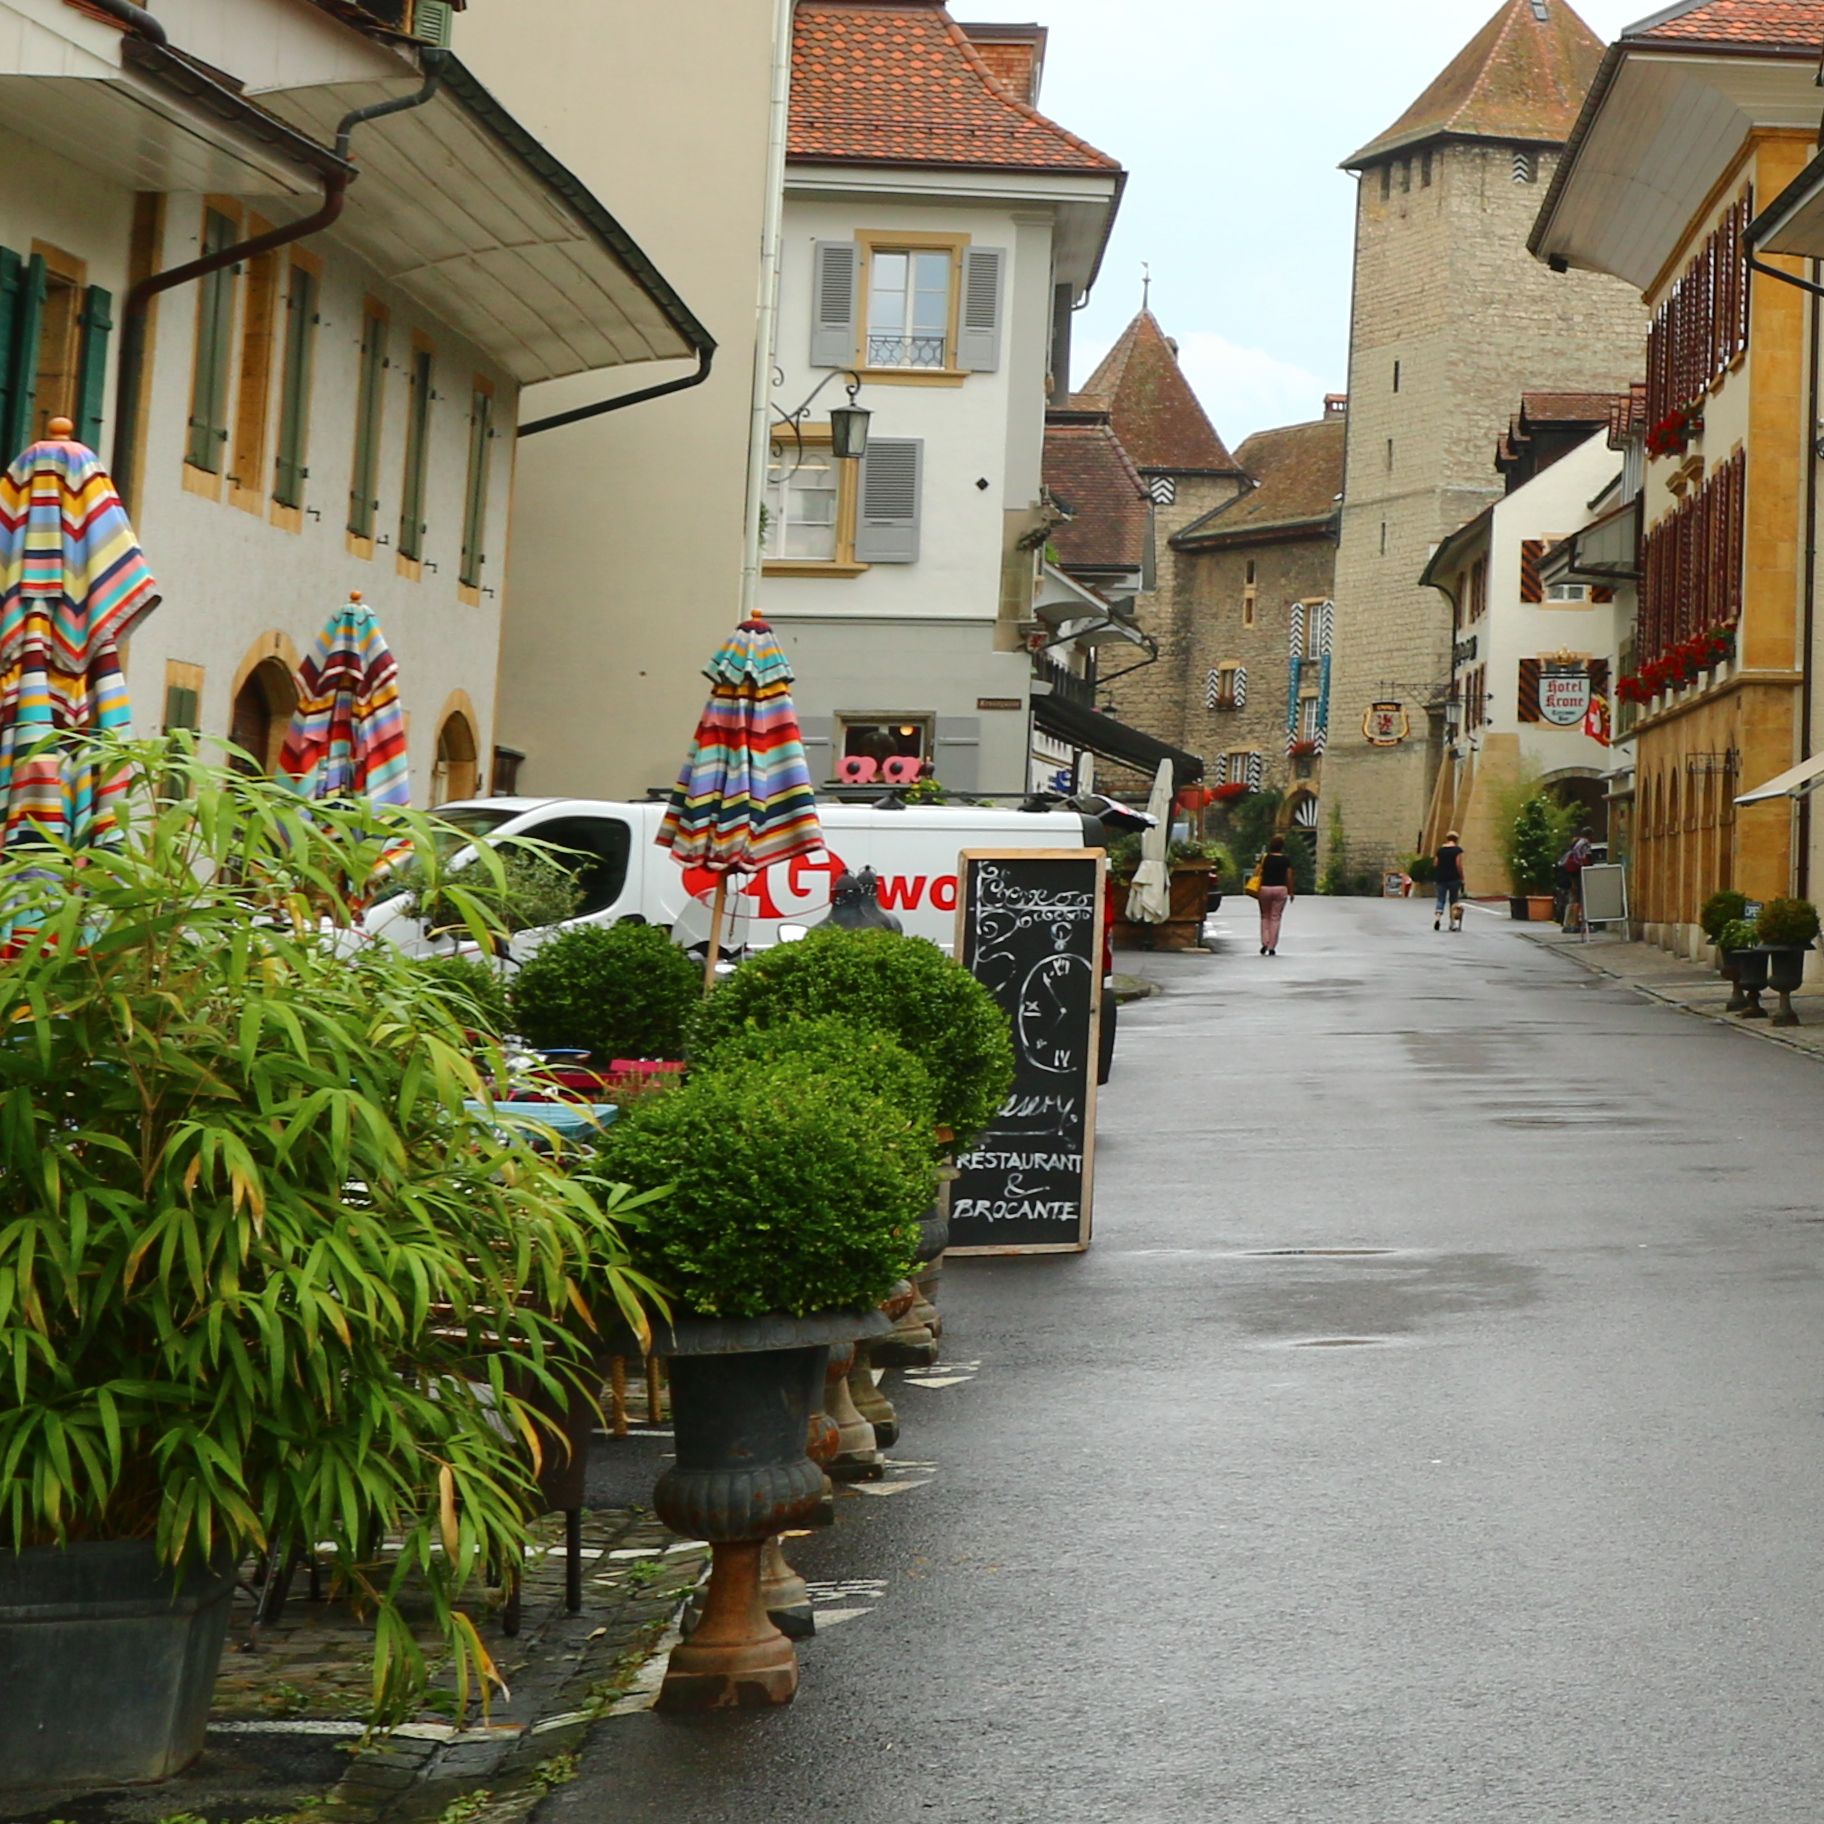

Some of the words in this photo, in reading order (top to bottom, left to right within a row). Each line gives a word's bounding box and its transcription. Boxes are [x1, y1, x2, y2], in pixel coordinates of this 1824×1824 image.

[1547, 679, 1583, 694] Hotel
[1546, 694, 1584, 707] Krone
[1003, 1172, 1051, 1199] &
[952, 1198, 1079, 1223] BROCANTE
